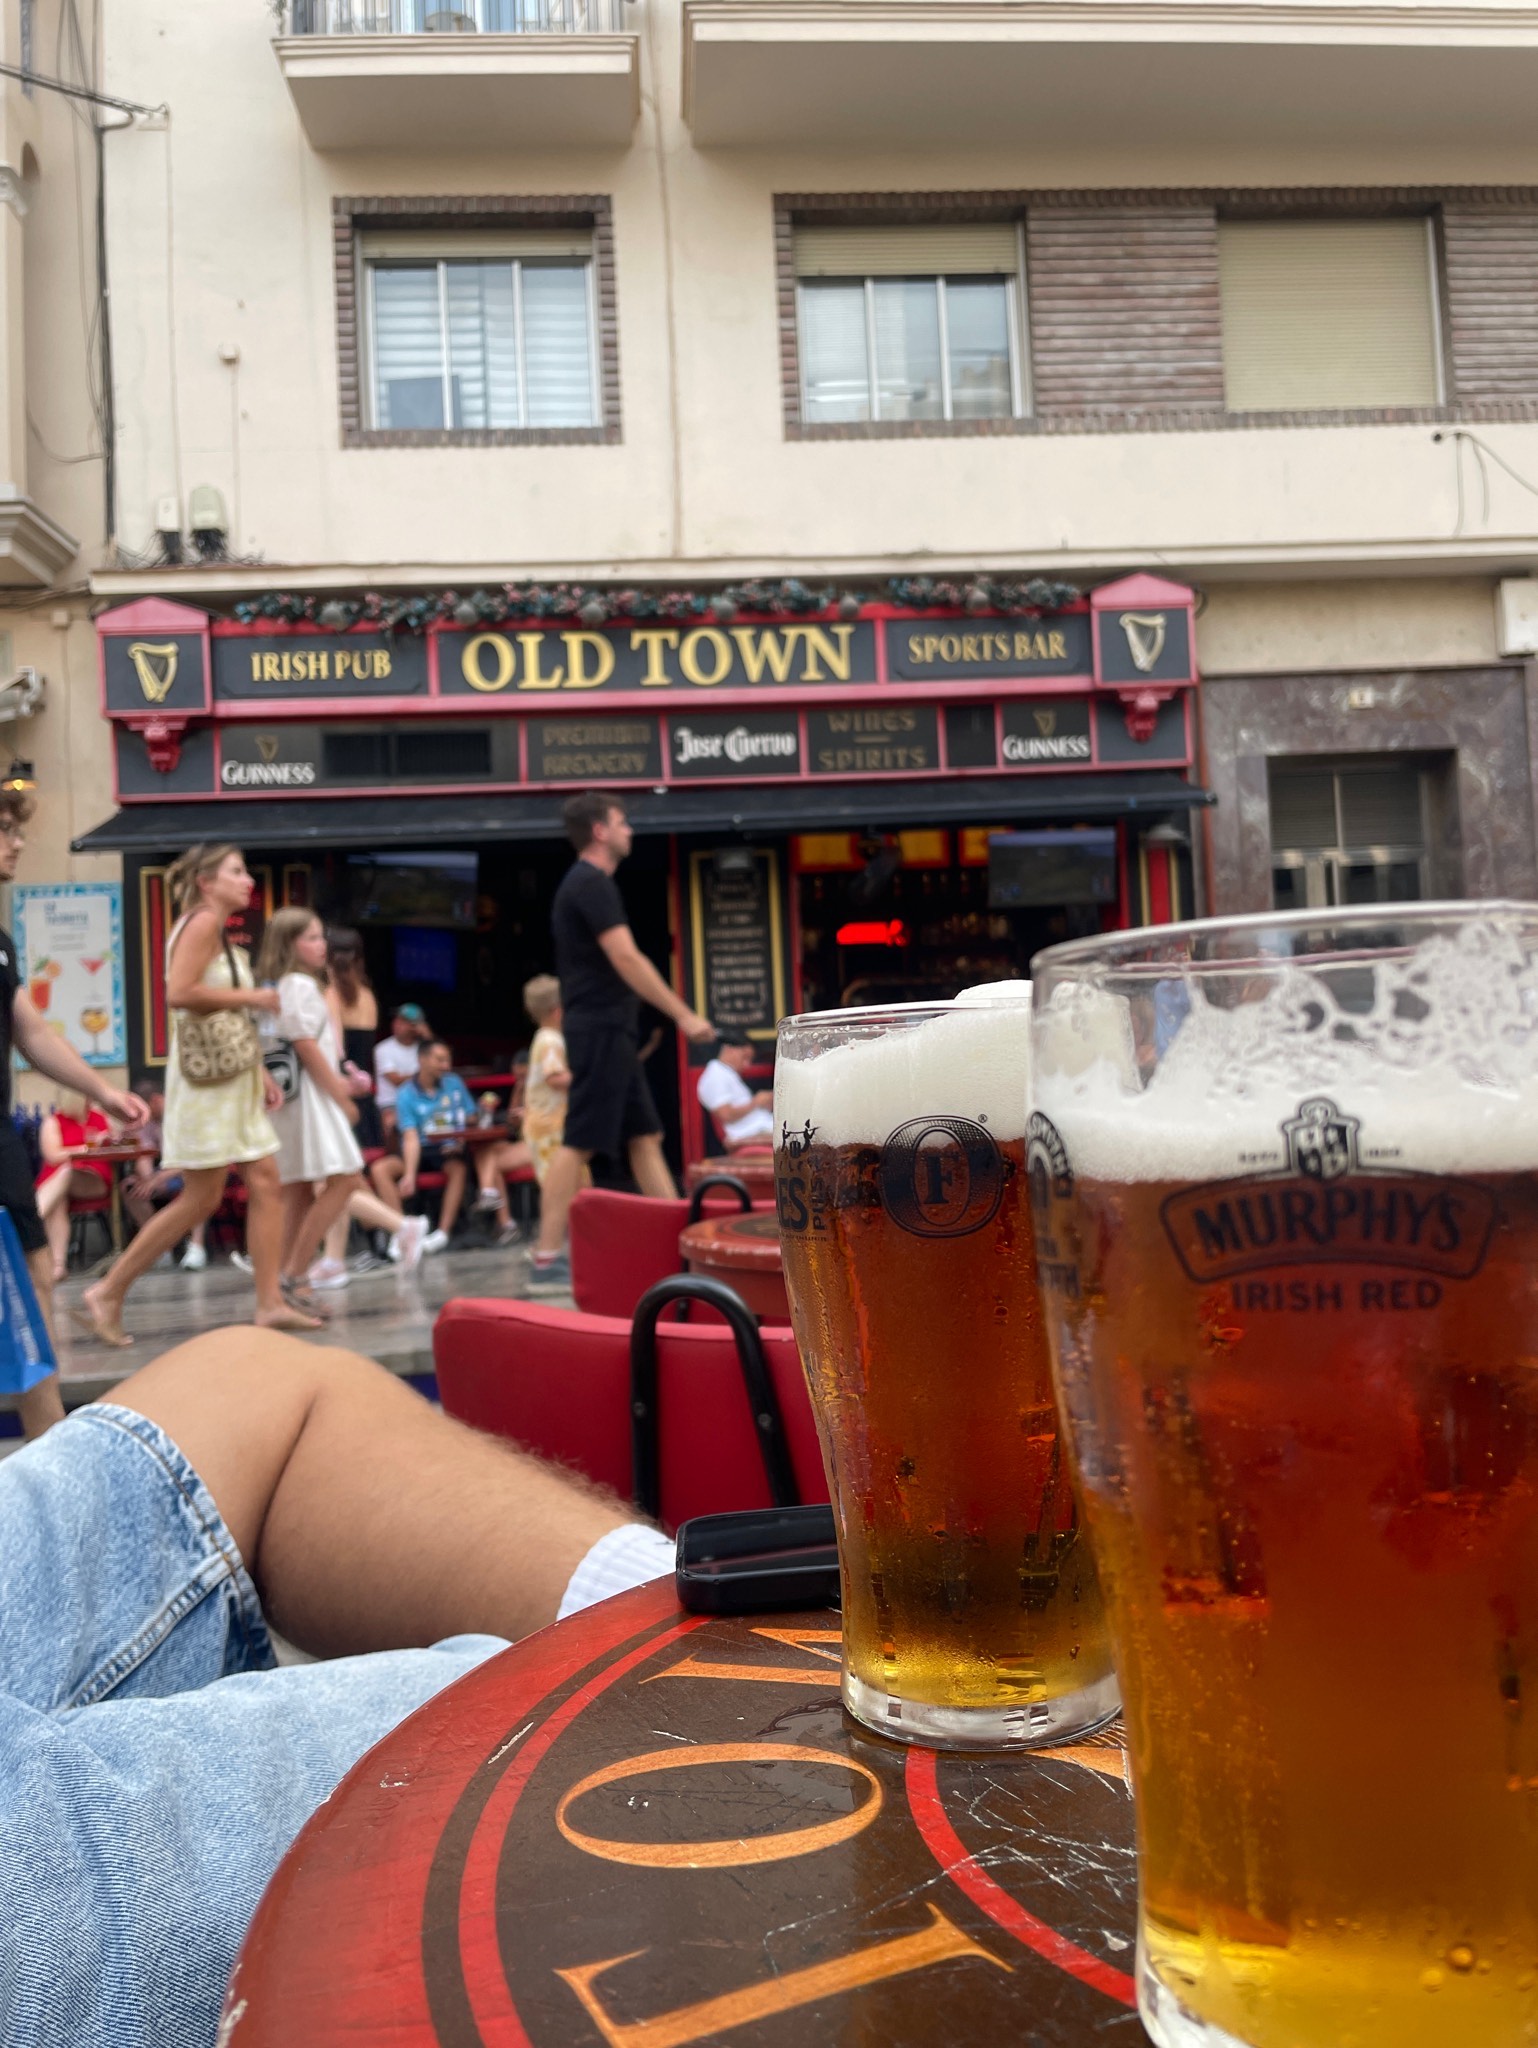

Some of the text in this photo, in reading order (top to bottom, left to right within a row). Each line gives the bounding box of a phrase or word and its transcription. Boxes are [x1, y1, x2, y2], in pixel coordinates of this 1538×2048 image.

[462, 624, 856, 692] OLD TOWN
[908, 631, 1068, 664] SPORTS BAR
[251, 649, 392, 682] IRISH PUB
[826, 709, 916, 733] WINES
[724, 726, 797, 763] Cuervo
[818, 747, 927, 771] SPIRITS
[1003, 735, 1091, 761] GUINNESS
[222, 760, 316, 786] GUINNESS
[542, 752, 648, 776] BREWERY
[1232, 1279, 1443, 1311] IRISH RED
